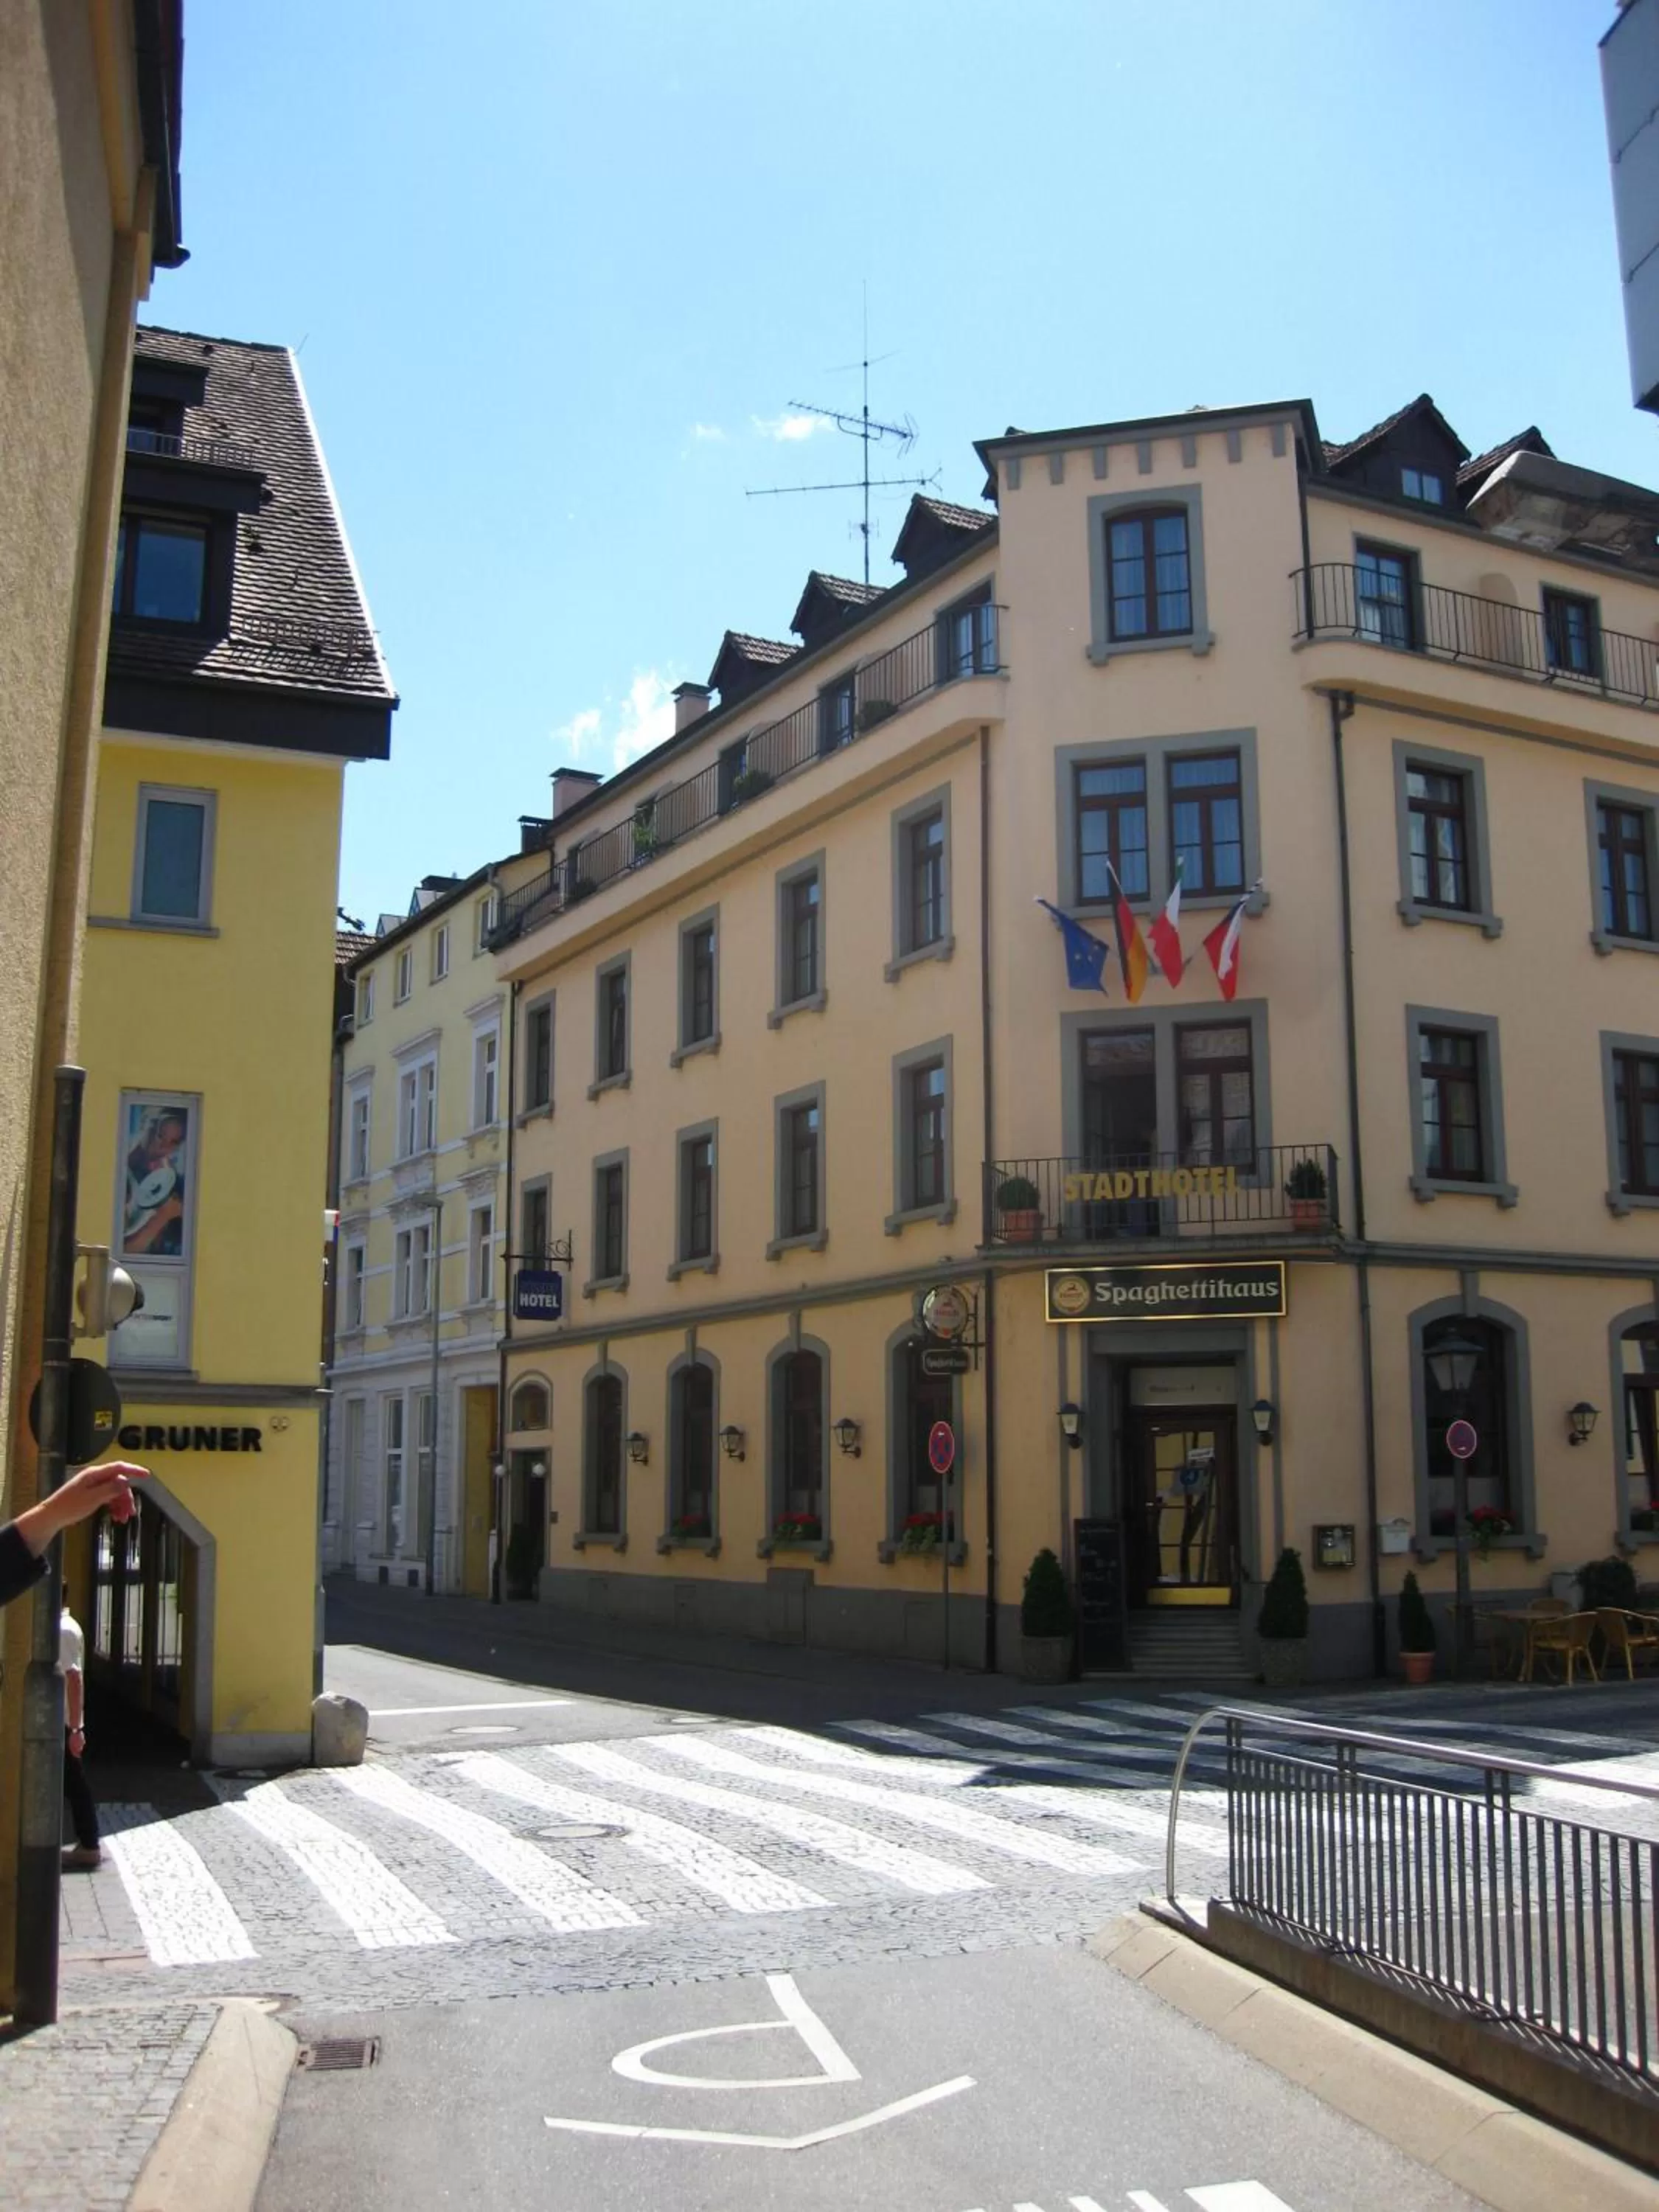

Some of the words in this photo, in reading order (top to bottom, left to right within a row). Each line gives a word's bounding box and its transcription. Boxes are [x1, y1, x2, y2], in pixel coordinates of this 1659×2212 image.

[1065, 1166, 1240, 1201] STADTHOTEL
[520, 1293, 559, 1307] HOTEL
[1095, 1277, 1279, 1305] Spaghettihaus
[118, 1425, 262, 1452] GRUNER
